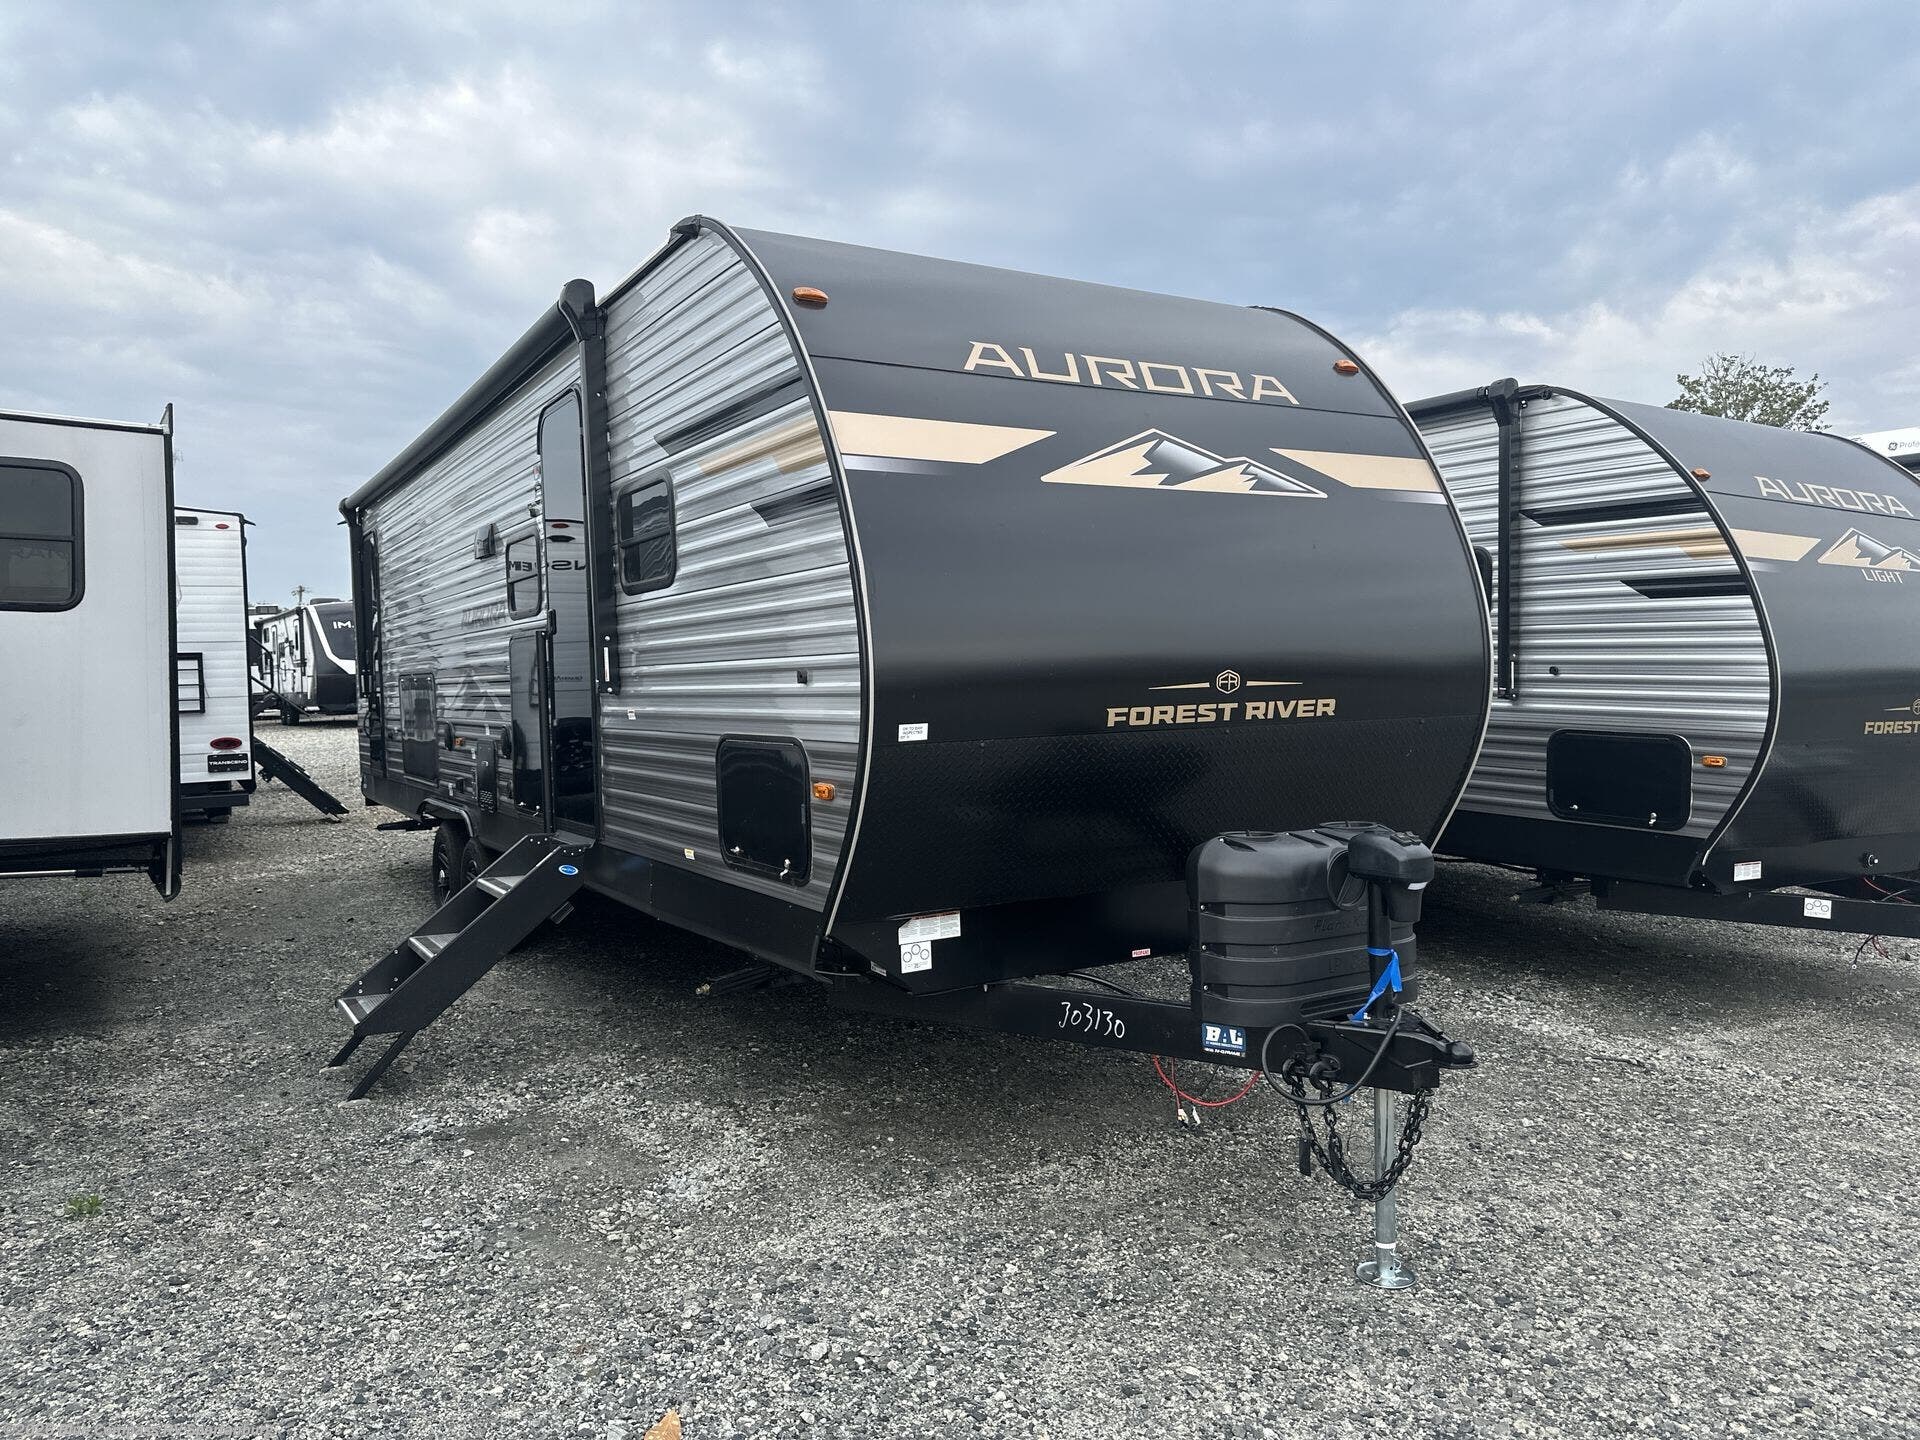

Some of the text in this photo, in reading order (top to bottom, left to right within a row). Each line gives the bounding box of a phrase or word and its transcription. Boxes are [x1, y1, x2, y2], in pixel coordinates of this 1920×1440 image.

[963, 341, 1300, 405] AURORA
[1754, 475, 1914, 517] AURORA
[1861, 568, 1903, 583] LIGHT
[1106, 698, 1337, 727] FOREST RIVER
[1864, 720, 1920, 735] FOREST
[1058, 1001, 1125, 1038] 303130
[1205, 1025, 1243, 1046] BAL
